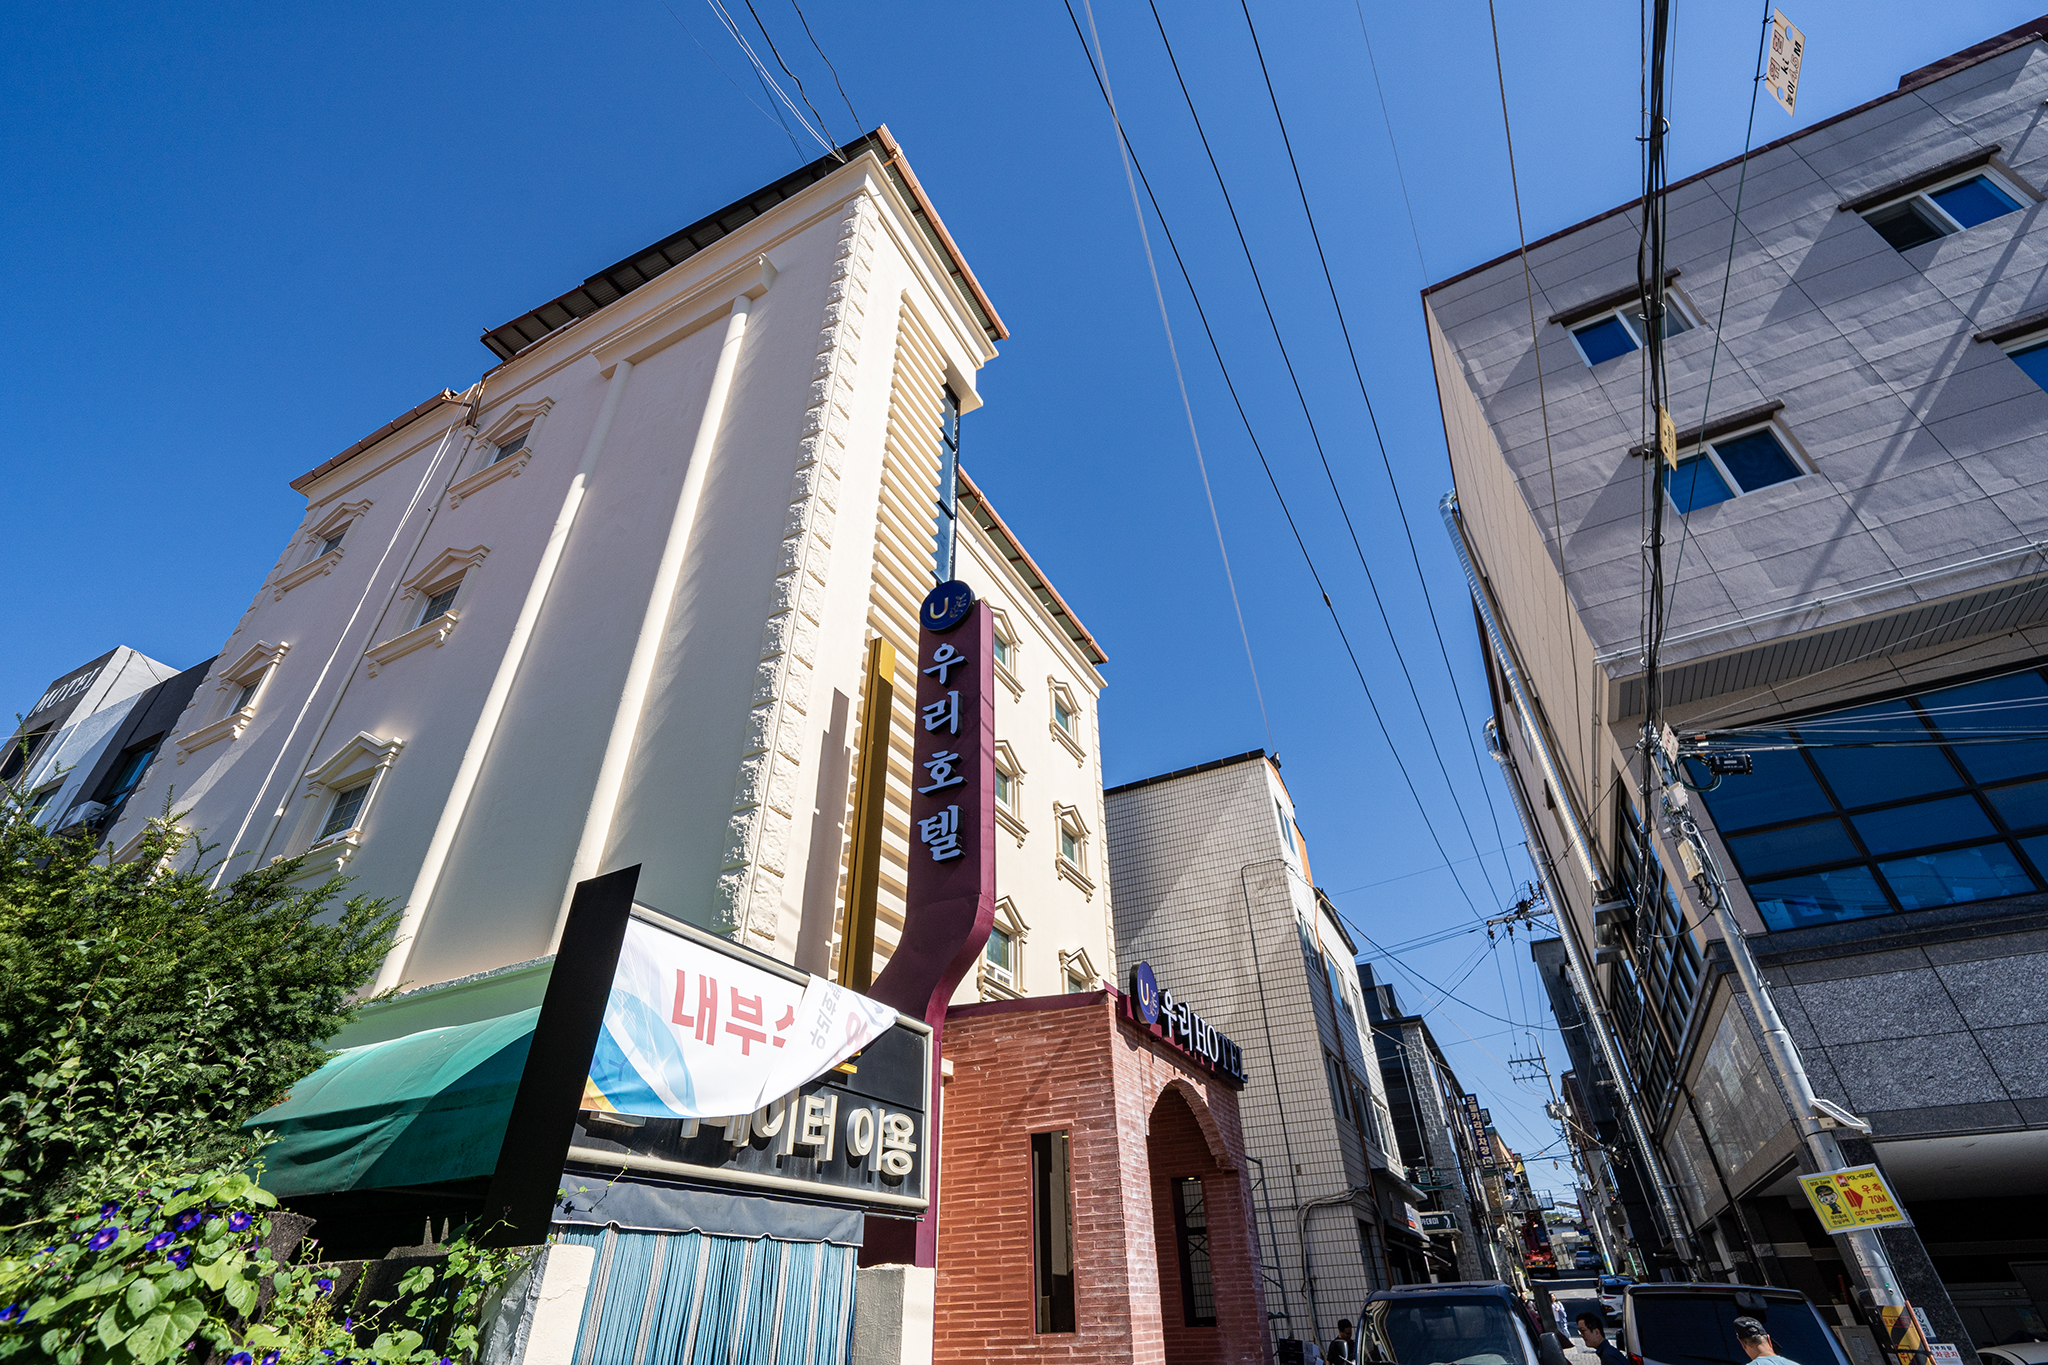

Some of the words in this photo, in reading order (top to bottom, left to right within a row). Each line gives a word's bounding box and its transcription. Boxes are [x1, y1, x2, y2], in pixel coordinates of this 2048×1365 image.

[28, 666, 101, 718] MOTEL
[917, 642, 968, 863] 우리호텔
[846, 1107, 918, 1177] 이용
[1868, 1194, 1887, 1204] 70M
